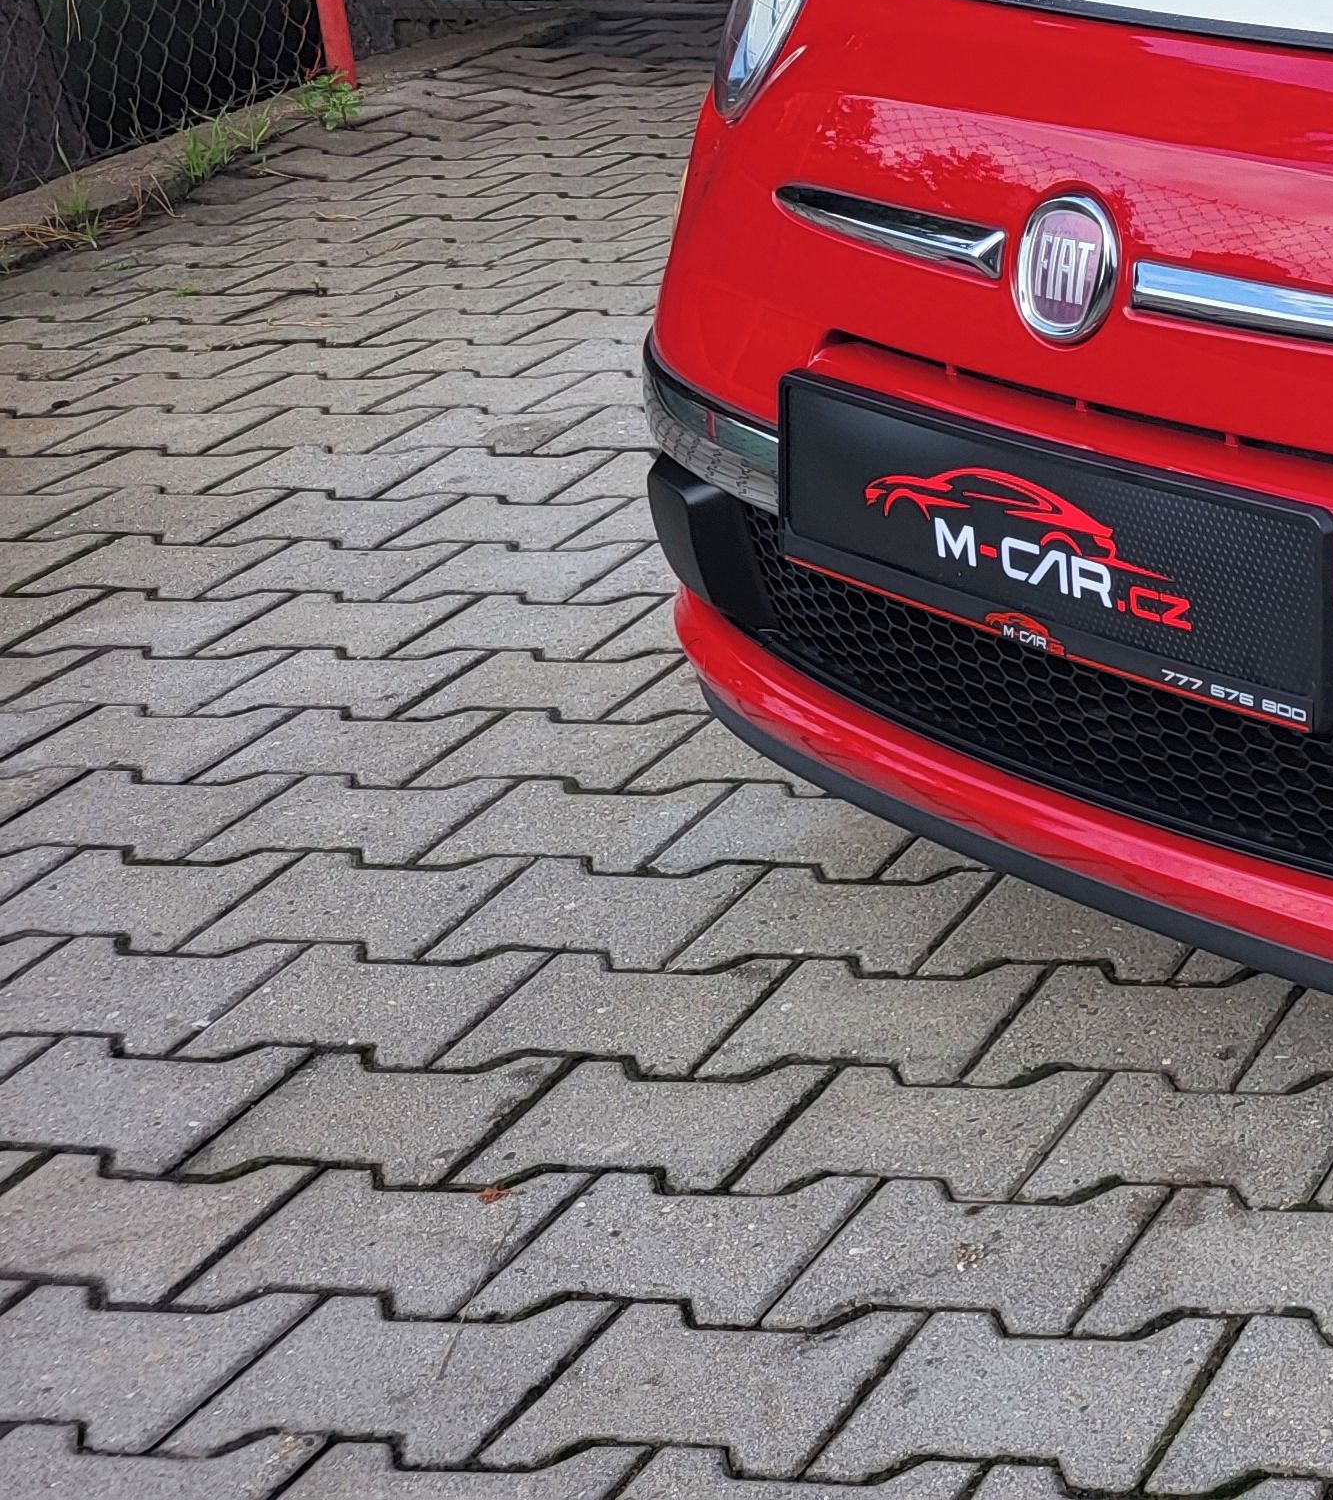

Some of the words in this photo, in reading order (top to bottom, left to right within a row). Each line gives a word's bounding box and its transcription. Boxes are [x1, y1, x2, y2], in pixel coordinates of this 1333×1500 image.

[1034, 232, 1096, 306] FIAT
[1161, 668, 1203, 690] 777
[1210, 683, 1254, 707] 676
[1262, 699, 1306, 722] 800
